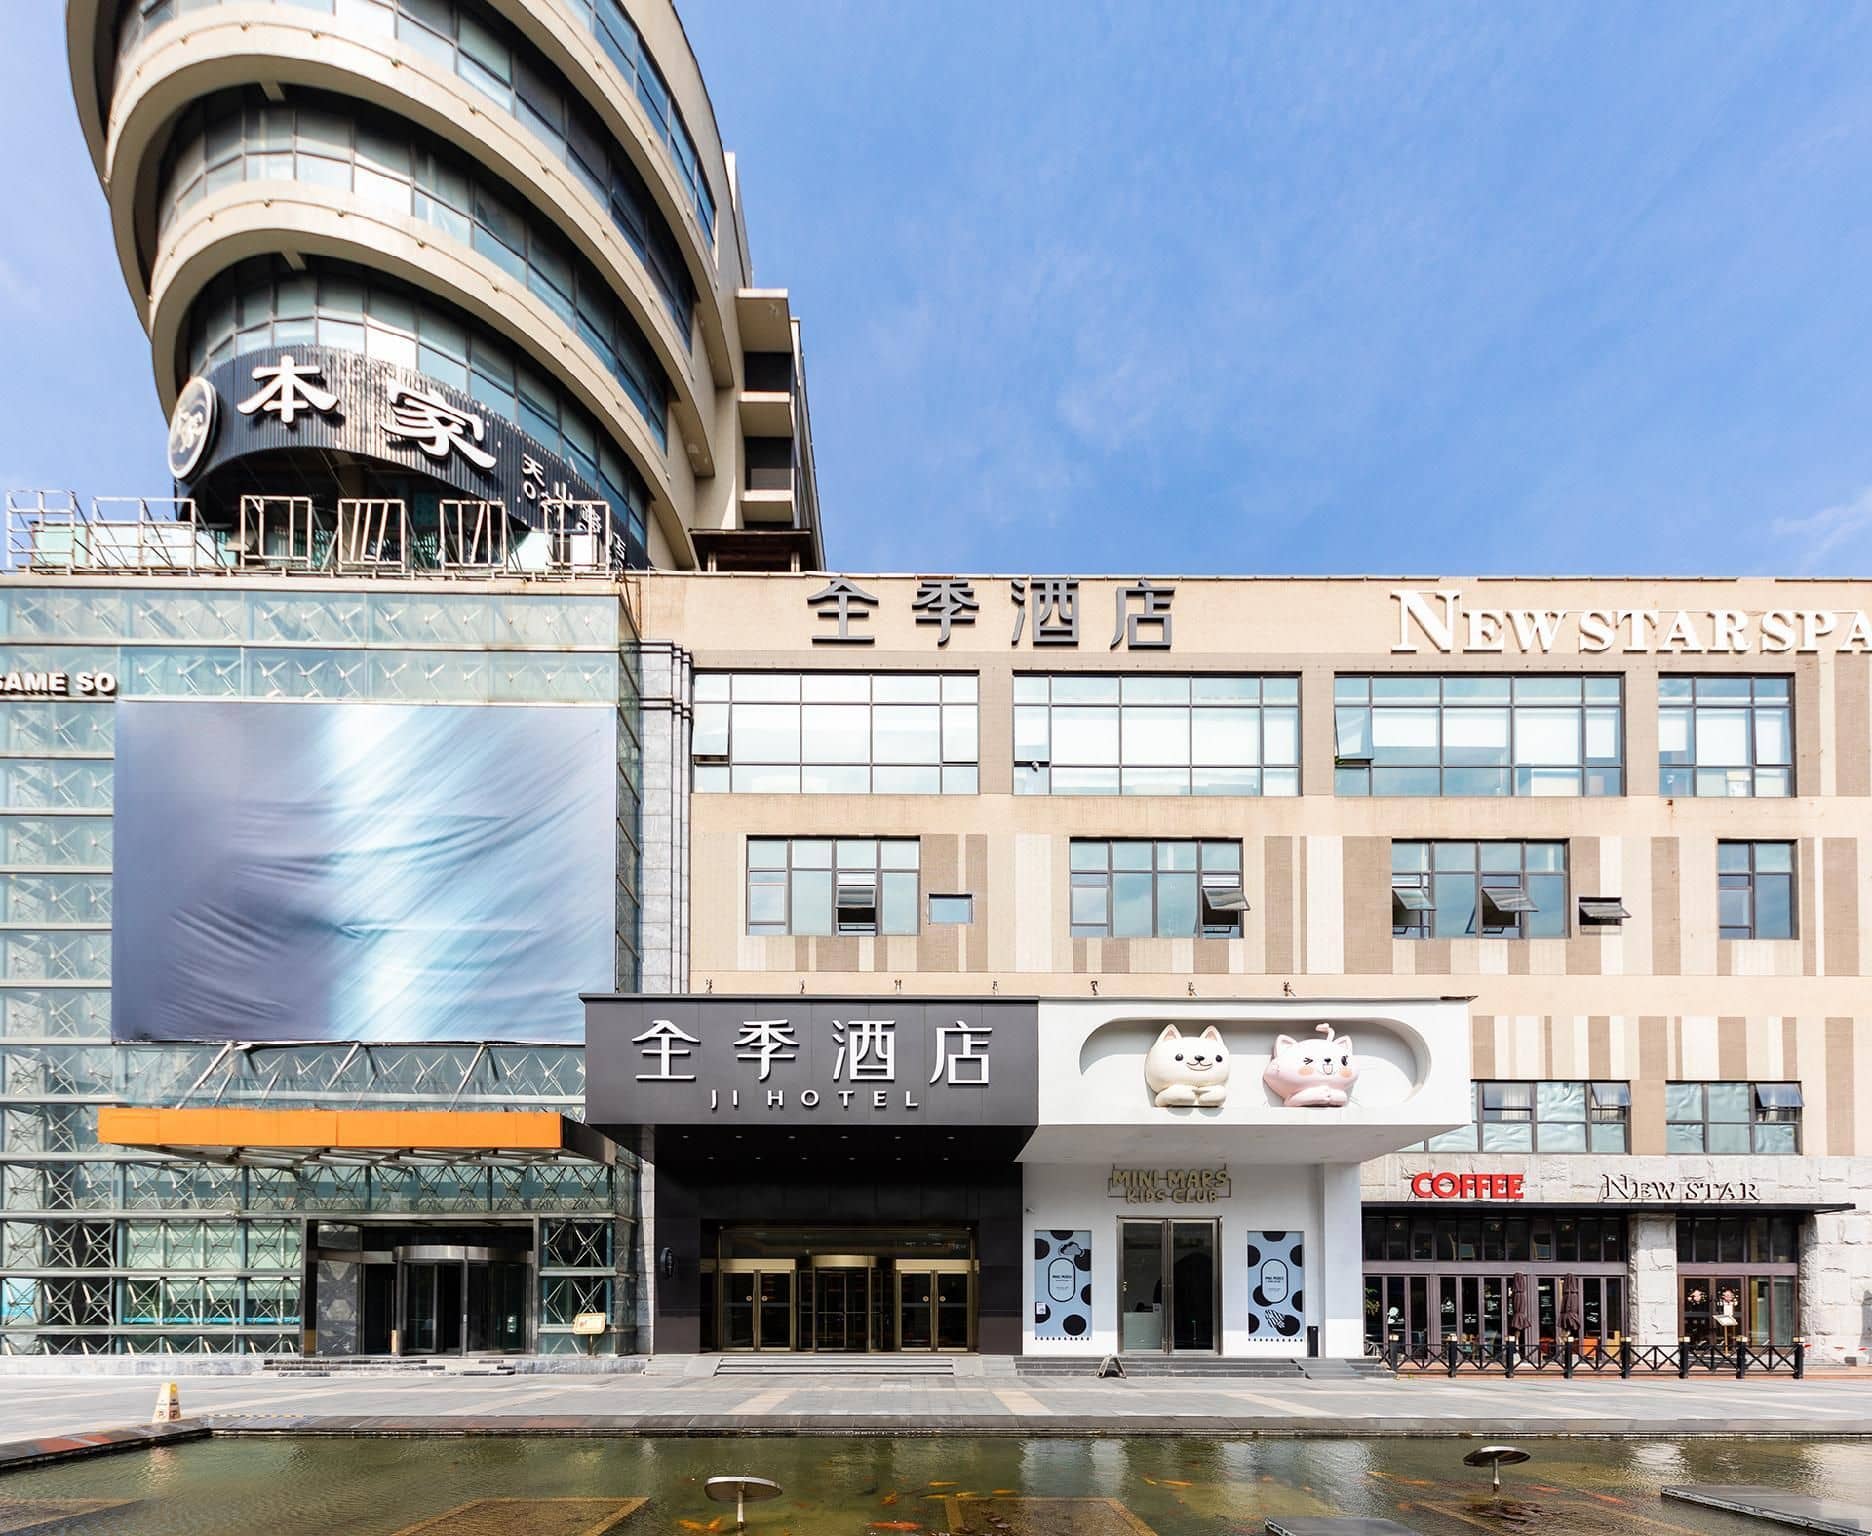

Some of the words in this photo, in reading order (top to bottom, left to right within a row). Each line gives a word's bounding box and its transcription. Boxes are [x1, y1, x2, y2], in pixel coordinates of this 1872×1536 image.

[237, 355, 497, 470] 本家
[807, 578, 1176, 650] 全季酒店
[0, 671, 67, 694] AME
[631, 1019, 994, 1085] 全季酒店
[711, 1090, 739, 1110] JI
[767, 1090, 920, 1109] HOTEL
[1112, 1169, 1159, 1189] MINI
[1167, 1169, 1228, 1189] MARS
[1410, 1172, 1525, 1200] COFFEE
[1601, 1173, 1677, 1201] NEW
[1684, 1181, 1761, 1201] STAR
[1126, 1188, 1166, 1204] KIDS
[1172, 1188, 1218, 1204] CLUB
